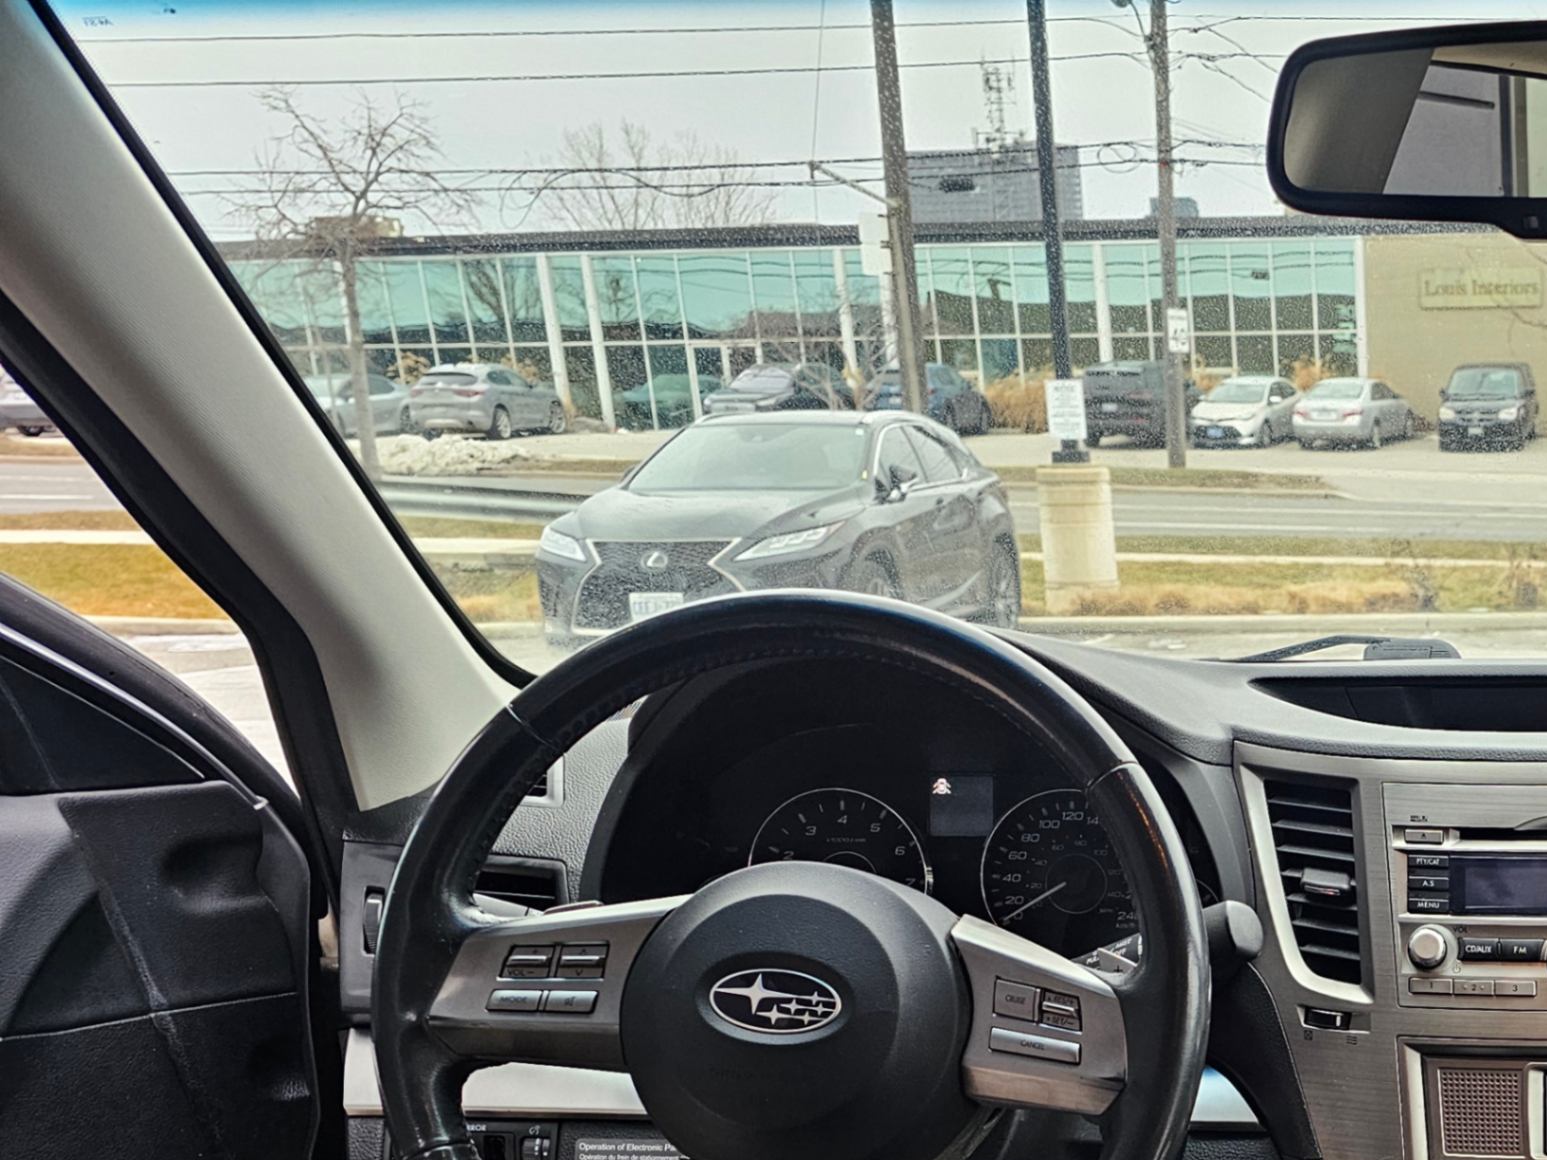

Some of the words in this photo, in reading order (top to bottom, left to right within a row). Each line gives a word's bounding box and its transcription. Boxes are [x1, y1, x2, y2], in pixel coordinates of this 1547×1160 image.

[1424, 280, 1467, 296] Louis
[1472, 280, 1539, 295] Interiors
[837, 815, 848, 824] 4
[1062, 811, 1084, 821] 120
[1087, 816, 1099, 825] 14
[870, 823, 881, 833] 5
[1039, 820, 1060, 829] 100
[805, 826, 817, 836] 3
[1021, 833, 1040, 843] 80
[894, 846, 906, 856] 6
[1008, 851, 1027, 860] 60
[1002, 873, 1021, 883] 40
[1004, 895, 1024, 905] 20
[1417, 901, 1440, 909] MENU
[1513, 946, 1527, 954] FM
[1471, 984, 1477, 992] 2
[1512, 984, 1518, 992] 3
[579, 1142, 615, 1151] Operation
[617, 1143, 625, 1151] of
[626, 1143, 662, 1151] Electronic
